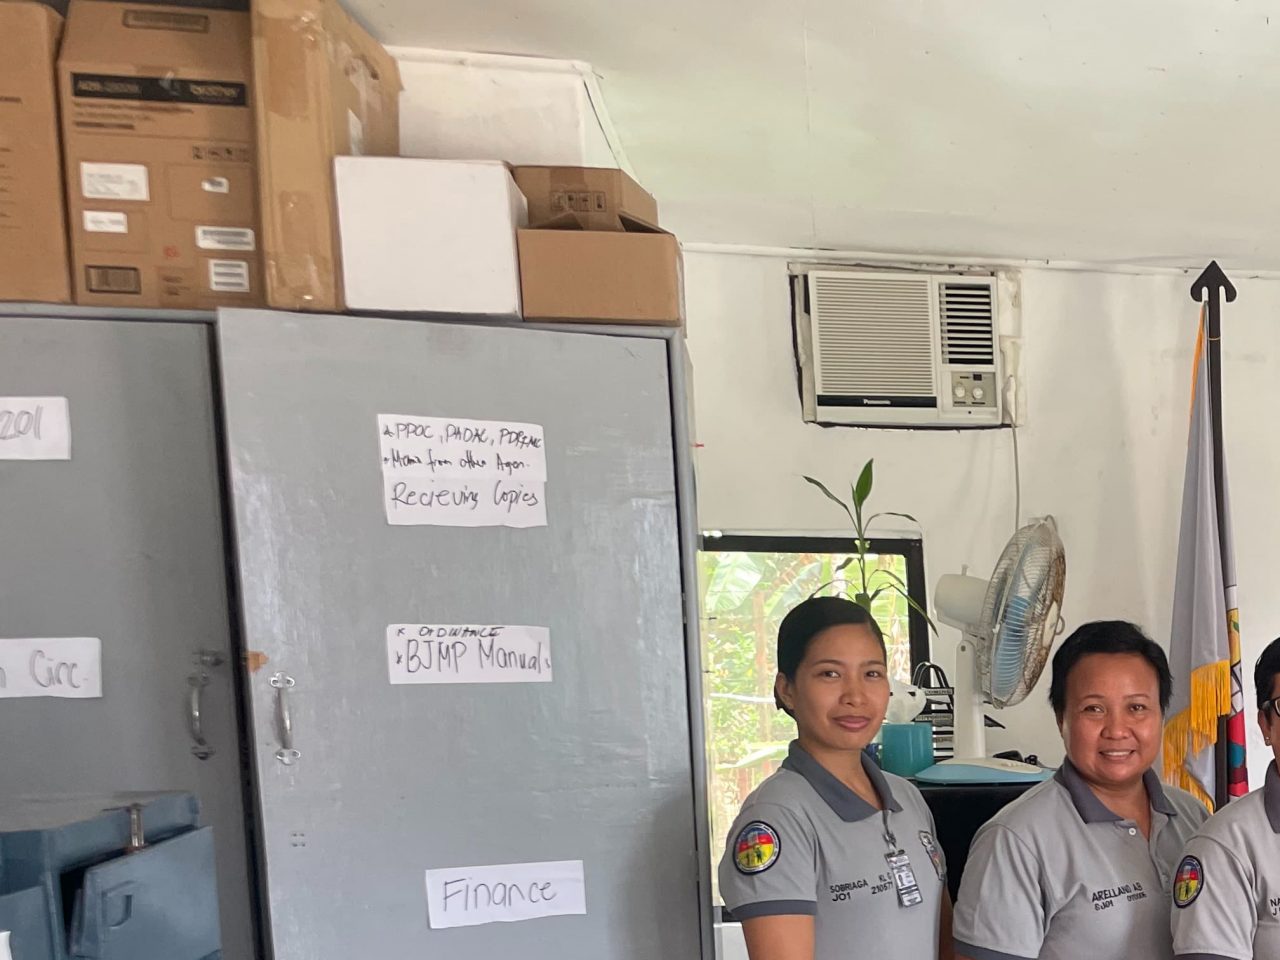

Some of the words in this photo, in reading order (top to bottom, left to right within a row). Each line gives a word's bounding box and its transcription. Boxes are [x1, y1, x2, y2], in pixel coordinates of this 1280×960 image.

[494, 480, 539, 513] Copies
[406, 638, 467, 674] BJMP
[478, 638, 543, 674] Manual
[443, 876, 557, 912] Finance
[829, 879, 869, 894] SOBRIAGA
